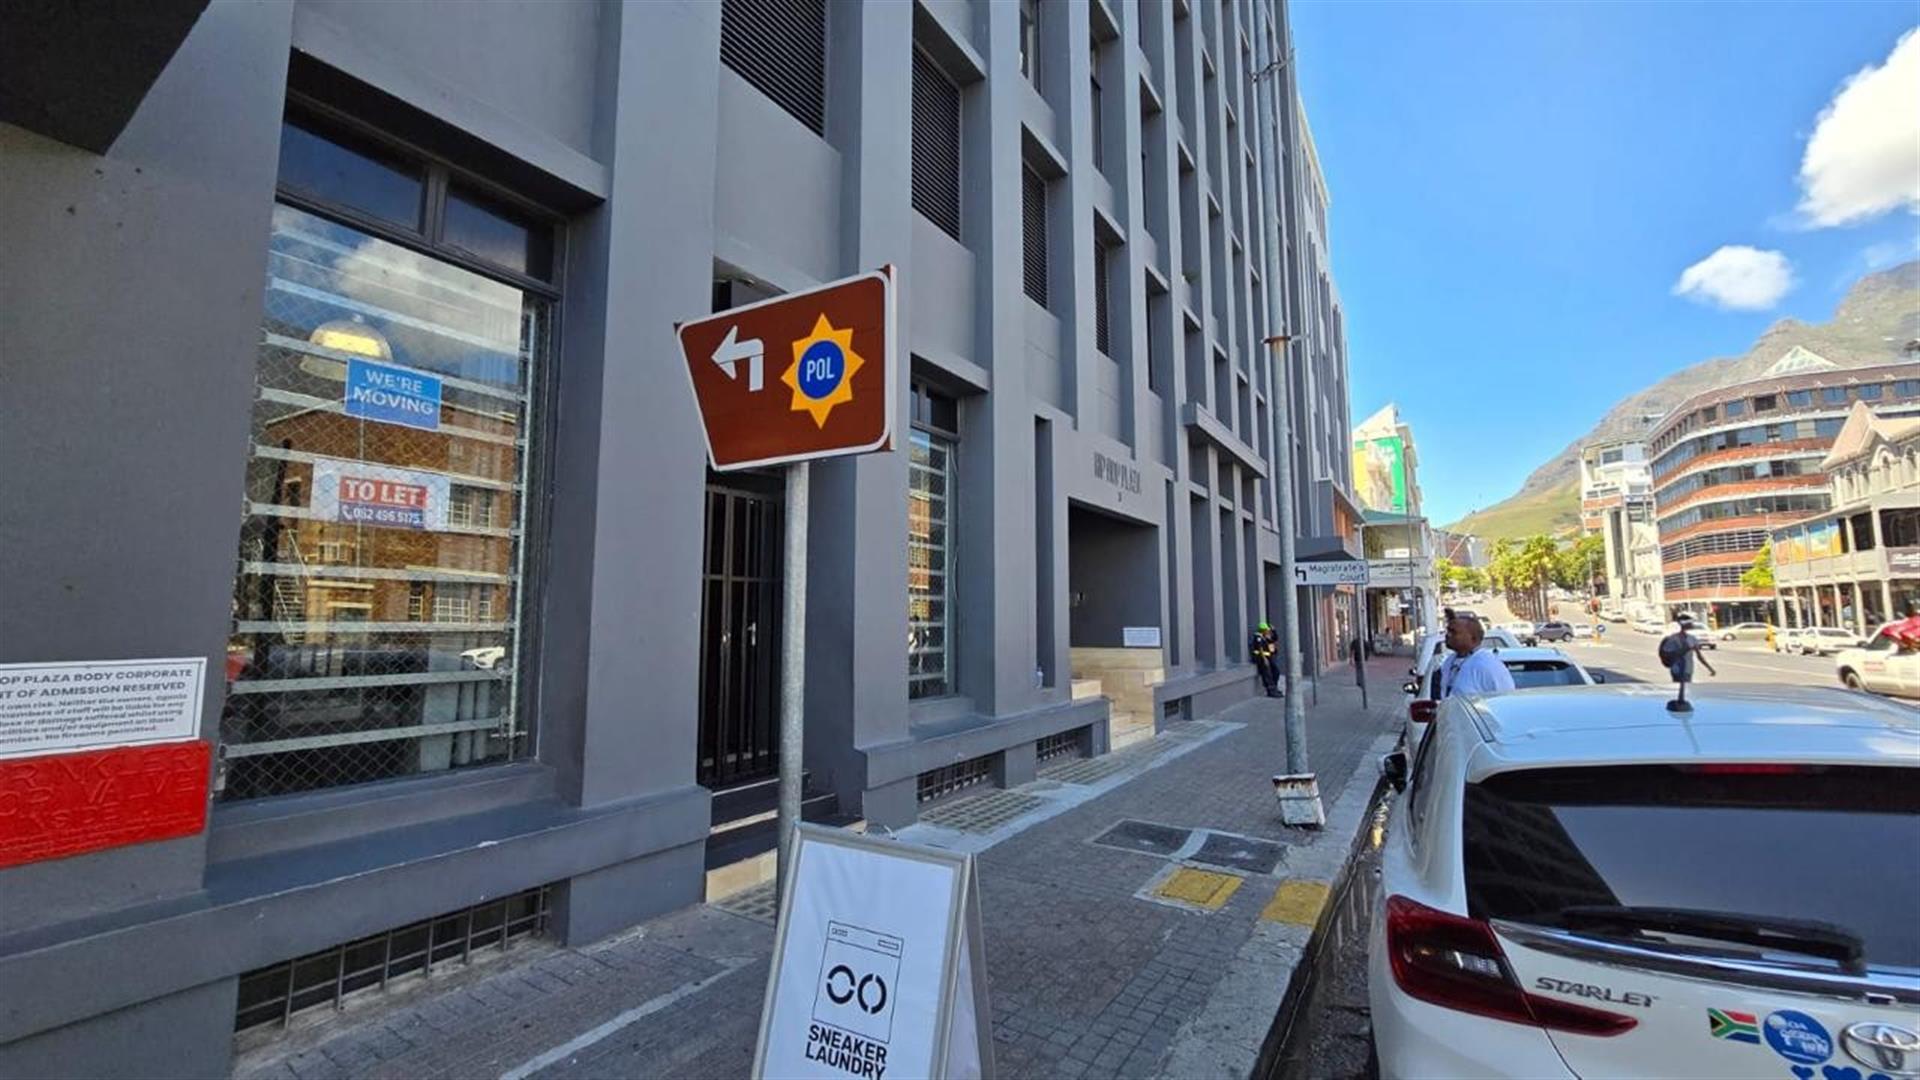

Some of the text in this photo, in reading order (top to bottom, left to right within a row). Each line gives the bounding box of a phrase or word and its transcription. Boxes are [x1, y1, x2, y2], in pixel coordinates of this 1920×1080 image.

[366, 369, 423, 393] WE'RE
[807, 356, 835, 383] POL
[353, 386, 434, 415] MOVING
[345, 480, 421, 505] TO LET
[1309, 563, 1364, 574] Magistrate's
[1339, 573, 1365, 581] Court
[23, 674, 70, 683] PLAZA
[74, 671, 112, 681] BODY
[115, 669, 192, 679] CORPORATE
[17, 688, 37, 698] OF
[40, 685, 121, 696] ADMISSION
[122, 682, 186, 692] RESERVED
[1535, 977, 1656, 1007] STARLET
[808, 1024, 887, 1064] SNEAKER
[805, 1041, 886, 1080] LAUNDRY
